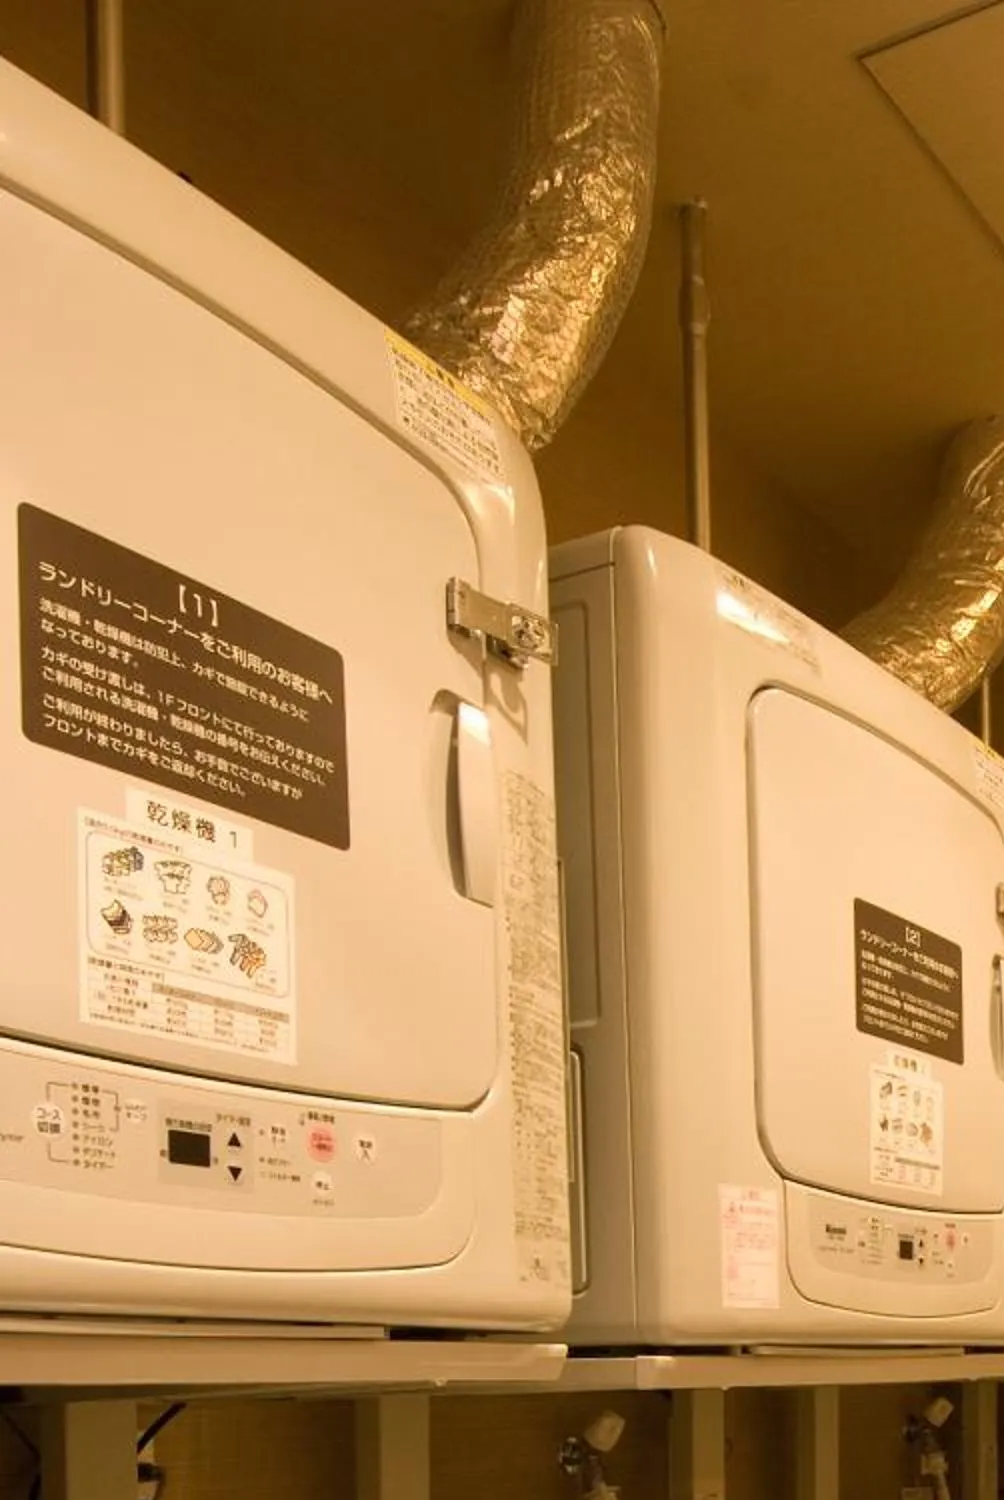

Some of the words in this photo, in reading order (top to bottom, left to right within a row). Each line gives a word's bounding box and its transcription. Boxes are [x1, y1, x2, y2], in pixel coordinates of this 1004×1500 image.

[38, 561, 333, 704] ランドリーコーナーをご利用のお客様へ
[147, 800, 216, 843] 乾燥機
[230, 831, 237, 848] 1
